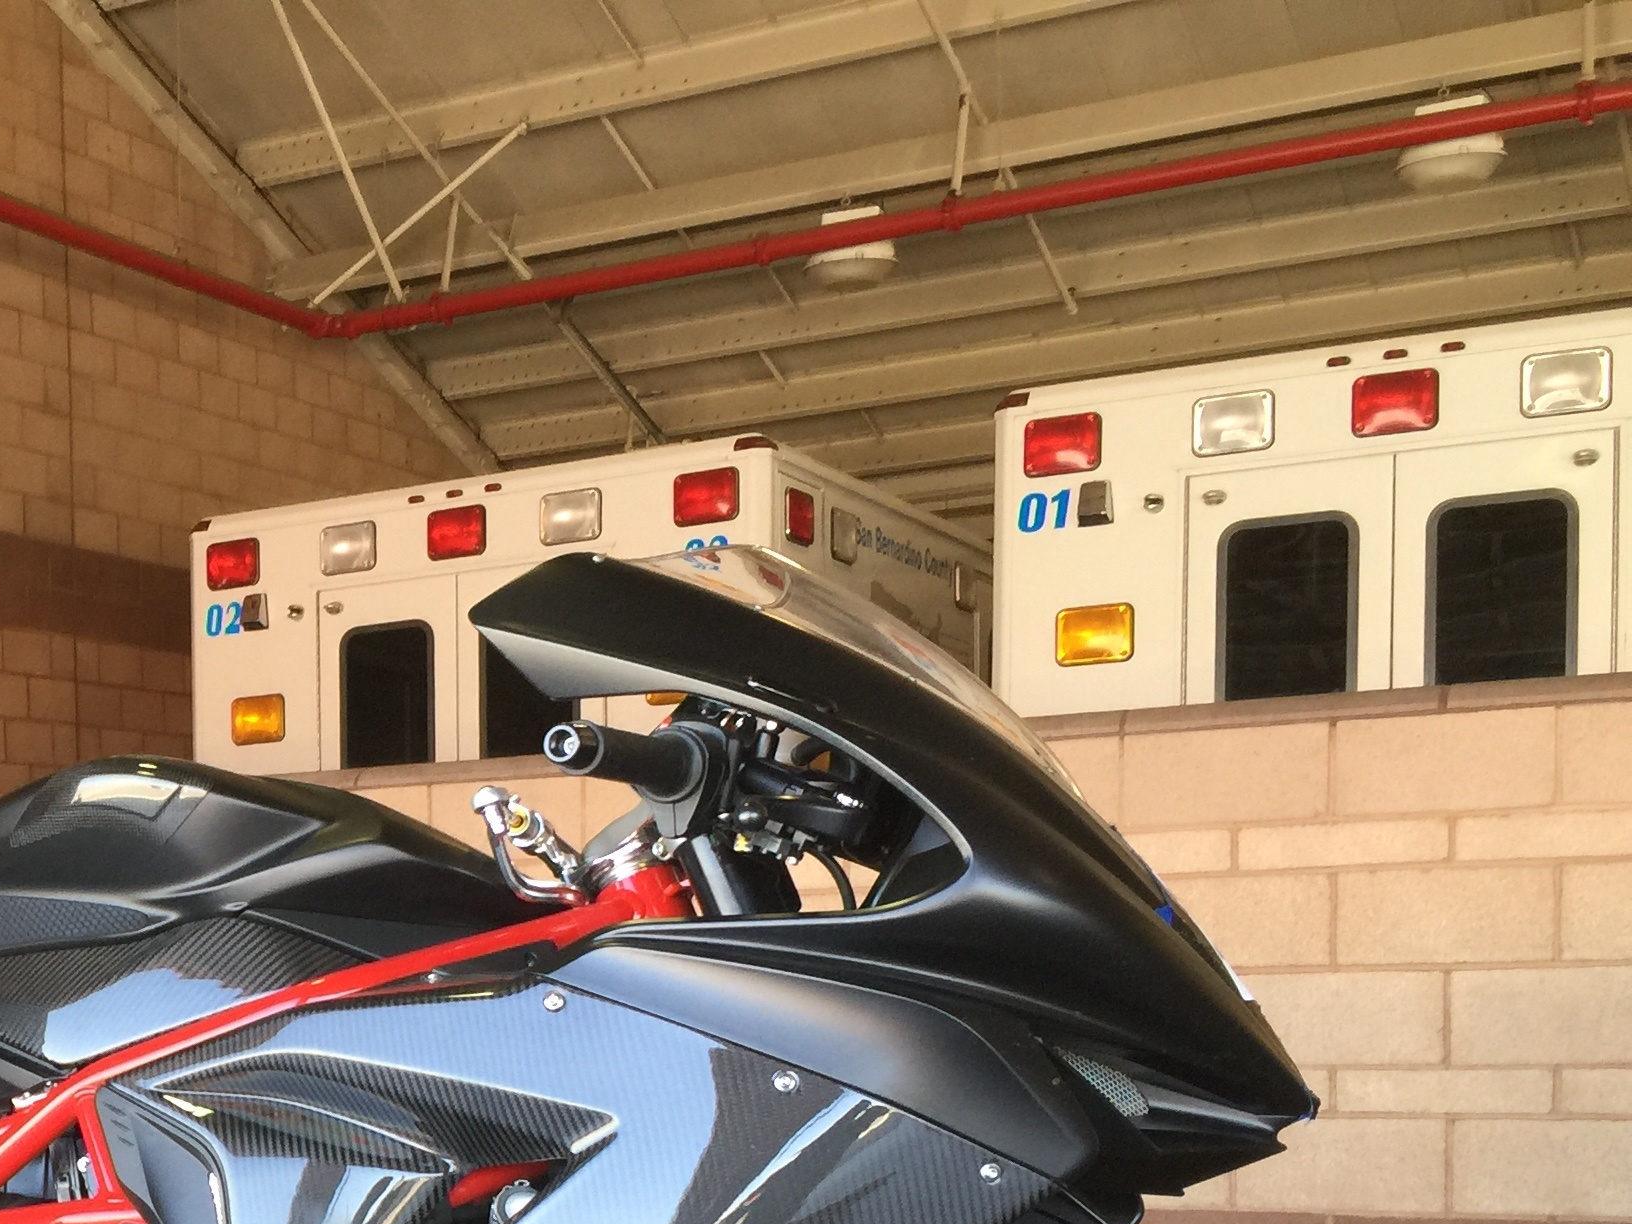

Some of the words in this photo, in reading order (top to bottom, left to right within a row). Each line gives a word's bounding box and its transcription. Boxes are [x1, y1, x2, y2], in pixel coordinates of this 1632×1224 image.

[1017, 488, 1071, 533] 01
[874, 526, 923, 571] Bernardino
[924, 546, 955, 589] County
[206, 601, 243, 637] 02
